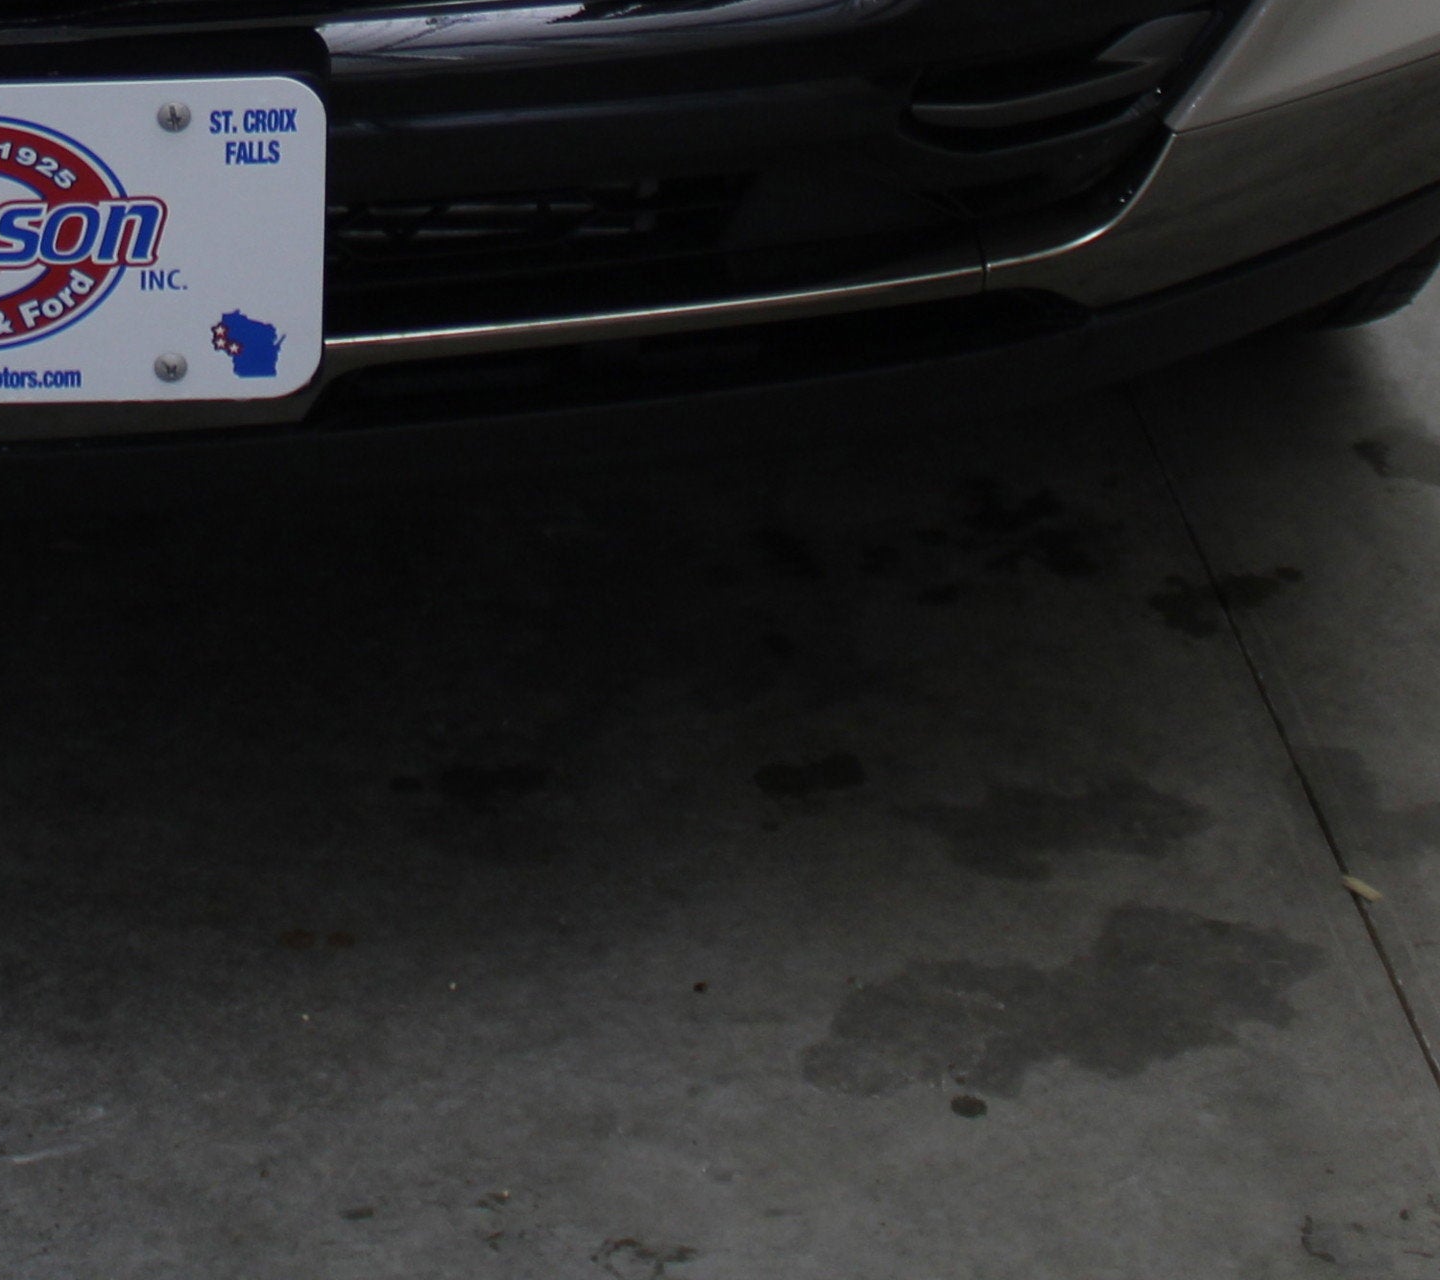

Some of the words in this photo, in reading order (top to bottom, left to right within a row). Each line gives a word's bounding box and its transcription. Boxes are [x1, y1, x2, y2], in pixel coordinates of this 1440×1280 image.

[208, 109, 238, 134] ST.
[243, 107, 298, 133] CROIX
[224, 140, 281, 165] FALLS
[140, 269, 189, 291] INC.
[18, 268, 96, 328] Ford
